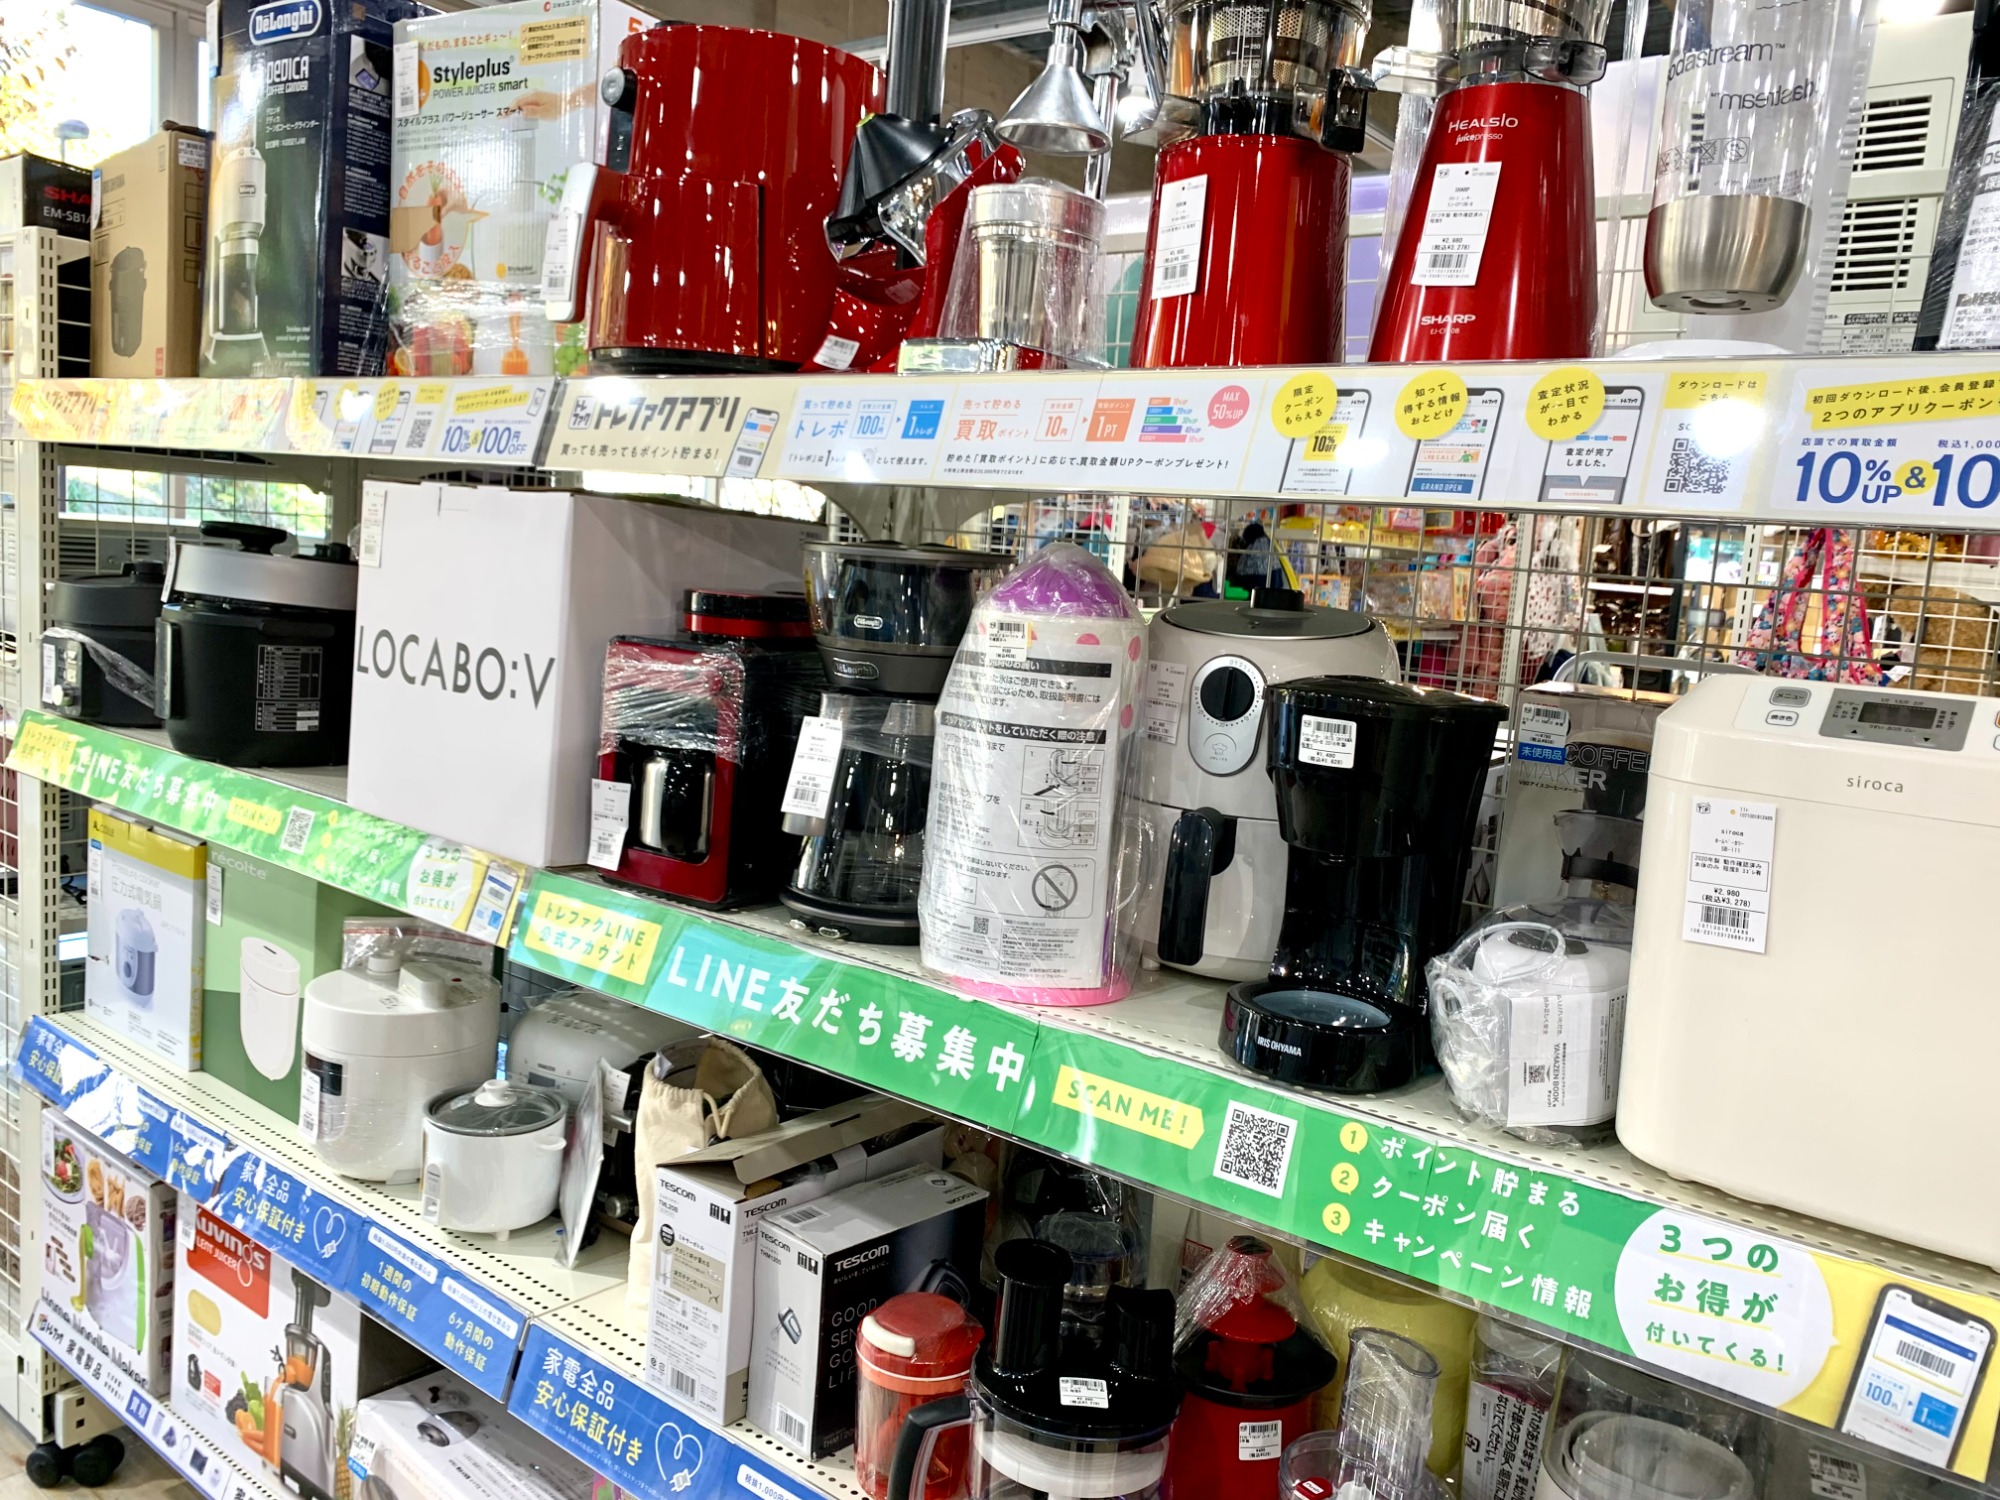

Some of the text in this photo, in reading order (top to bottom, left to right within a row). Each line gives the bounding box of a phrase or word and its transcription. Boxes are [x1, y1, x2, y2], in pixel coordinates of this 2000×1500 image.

[433, 57, 511, 86] Styleplus
[433, 77, 529, 99] POWER JUICER smart
[1448, 113, 1519, 134] HEALSIO
[1420, 313, 1477, 326] SHARP
[1222, 391, 1241, 402] MAX
[1293, 384, 1314, 397] 限定
[1415, 382, 1448, 398] 知って
[1537, 379, 1590, 401] 査定状況
[1677, 379, 1757, 391] ダウンロードは
[594, 396, 742, 433] トレファクアプリ
[802, 399, 853, 410] 買って貯める
[962, 398, 1022, 410] 売って貯める
[1284, 396, 1324, 413] クーポン
[1403, 392, 1462, 416] 得する情報
[1540, 395, 1589, 415] が一目で
[1285, 409, 1323, 425] もらえる
[1411, 408, 1454, 426] おとどけ
[1547, 411, 1583, 427] わかる
[441, 425, 463, 452] 10
[795, 420, 848, 440] トレポ
[953, 419, 1030, 442] 買取 ポイント
[508, 443, 527, 455] OFF
[560, 443, 720, 461] 買っても売ってもポイント貯まる!
[1312, 435, 1326, 452] 10
[1565, 447, 1614, 457] 査定が完了
[1800, 437, 1898, 448] 店頭での買取金額
[1566, 458, 1608, 468] しました。
[1420, 482, 1463, 492] GRAND OPEN
[1796, 450, 1862, 504] 10
[1861, 484, 1903, 504] UP
[1904, 465, 1927, 489] &
[356, 625, 556, 710] LOCABO:V
[1776, 692, 1804, 701] メニュー
[1521, 746, 1563, 761] 未使用品
[1518, 759, 1608, 792] MAKER
[1847, 775, 1904, 793] siroca
[211, 849, 267, 880] récolte
[1723, 858, 1762, 869] 動作確認済み
[1701, 894, 1751, 908] (税込¥3,278)
[1713, 887, 1741, 898] ¥2,980
[543, 901, 646, 948] トレファクLINE
[538, 925, 638, 971] 公式アカウント
[667, 945, 1026, 1093] LINE友だち募集中
[1257, 1035, 1303, 1057] IRIS OHYAMA
[1067, 1079, 1133, 1117] SCAN
[240, 1160, 291, 1205] 家全品
[1380, 1136, 1581, 1217] ポイント貯まる
[659, 1178, 697, 1203] TESCOM
[232, 1186, 307, 1244] 安心保証付き
[743, 1197, 787, 1219] TESCOM
[1338, 1170, 1535, 1250] 2 クーポン届く
[759, 1229, 792, 1253] TESCOM
[1659, 1223, 1779, 1273] 3つの
[834, 1243, 890, 1273] TESCOM
[1330, 1210, 1593, 1320] 3 キャンペーン情報
[378, 1260, 413, 1294] 1週間の
[360, 1270, 419, 1323] 初期動作保証
[1653, 1272, 1779, 1324] お得が
[443, 1331, 488, 1373] 動作保証
[1645, 1320, 1785, 1373] 付いてくる!
[65, 1338, 102, 1381] 家電製品
[542, 1346, 616, 1412] 家電全品
[1865, 1381, 1893, 1407] 100
[533, 1380, 645, 1468] 安心保証付き
